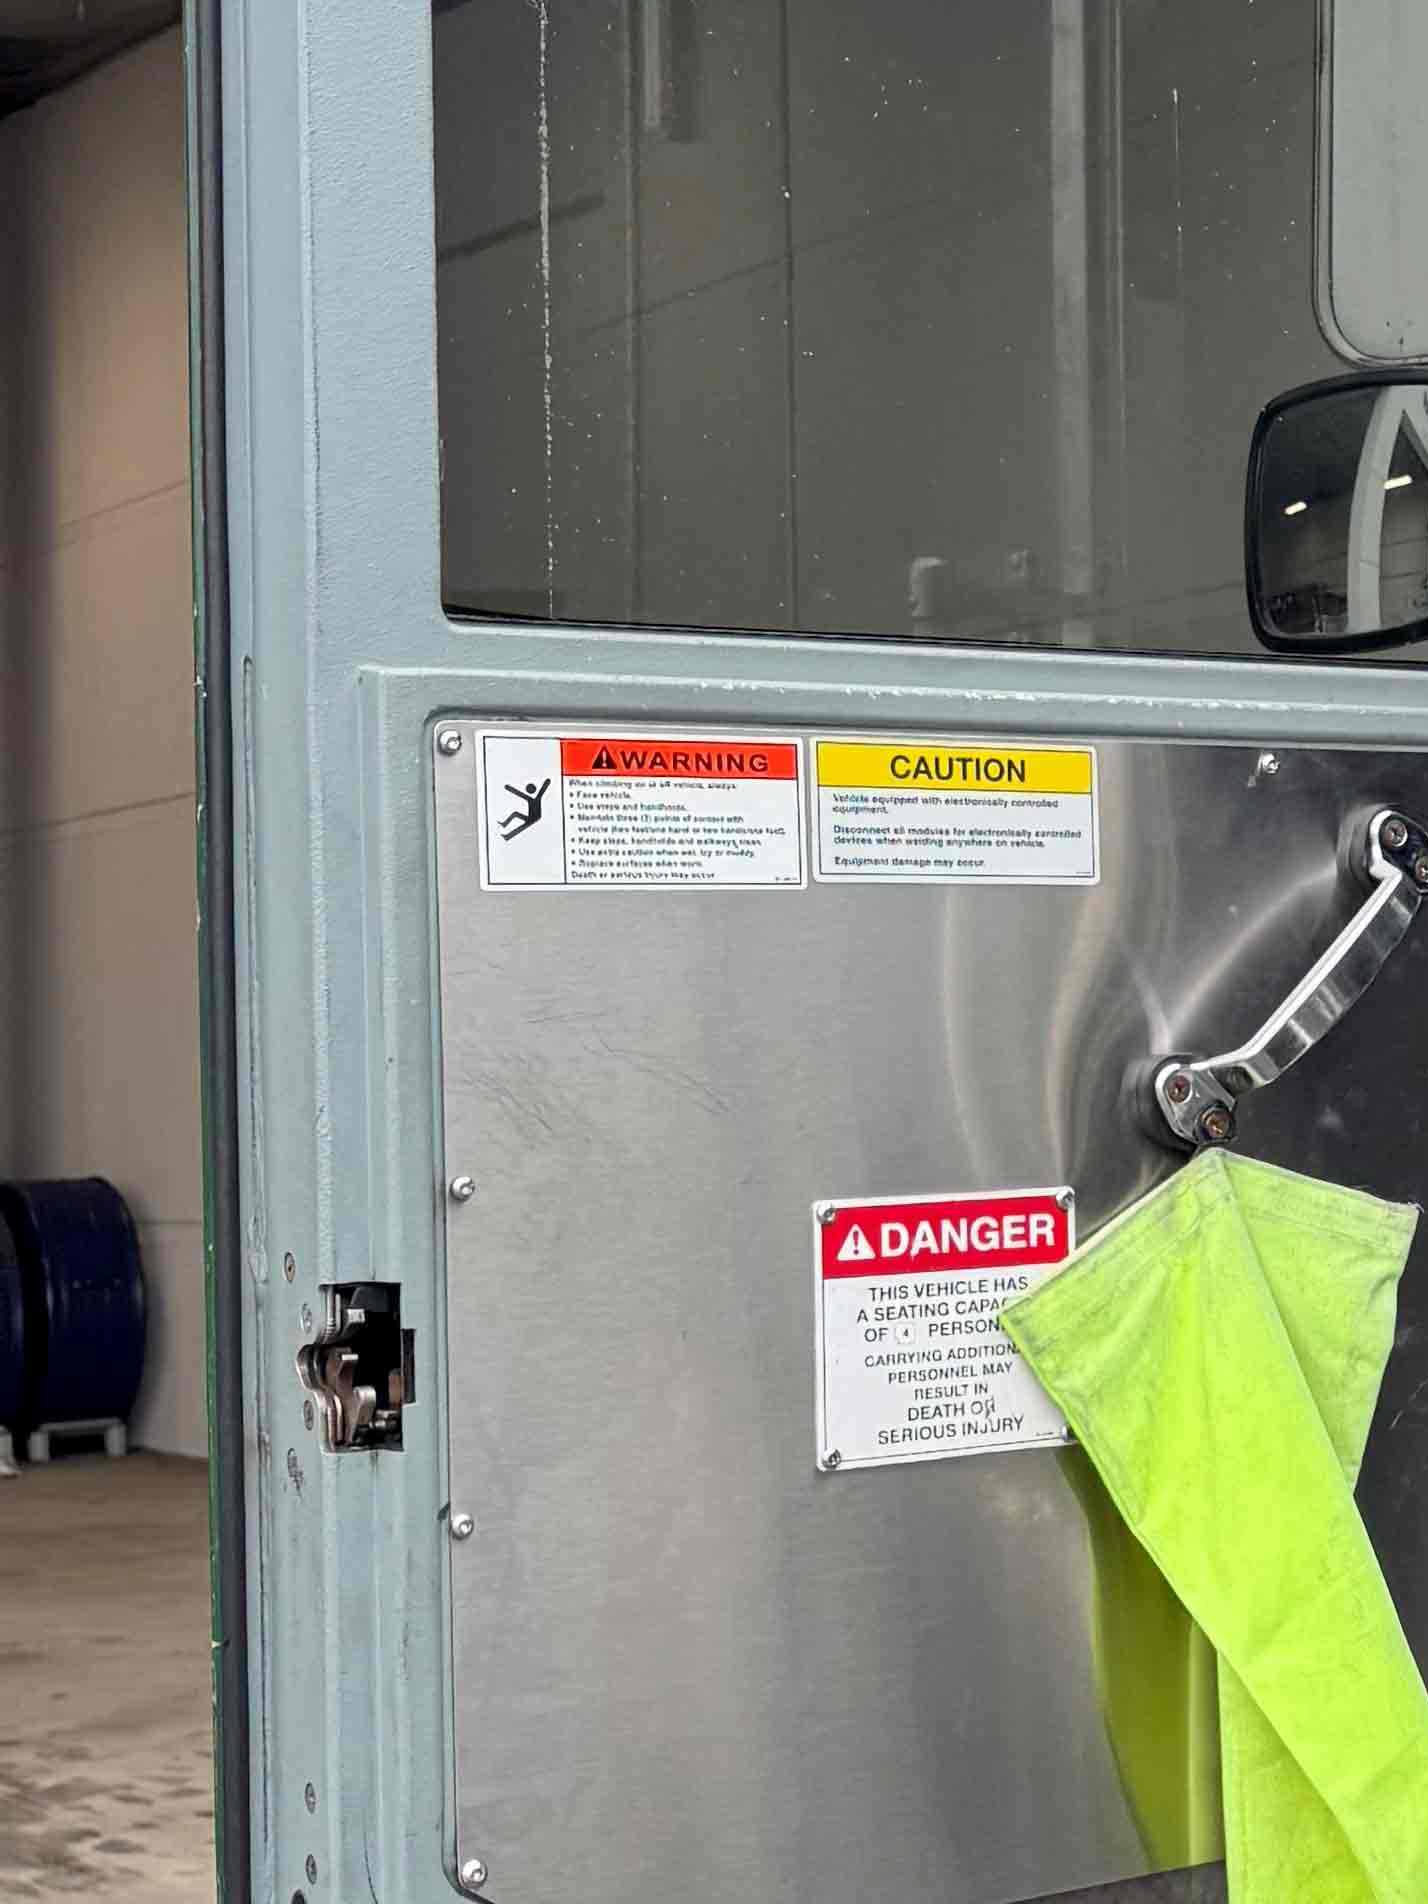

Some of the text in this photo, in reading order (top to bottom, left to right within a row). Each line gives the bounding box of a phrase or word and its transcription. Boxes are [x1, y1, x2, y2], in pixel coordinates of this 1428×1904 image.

[620, 751, 769, 772] WARNING
[890, 755, 1026, 783] CAUTION
[872, 796, 918, 805] equipped
[921, 796, 942, 804] with
[944, 797, 1008, 808] electronically
[1011, 799, 1058, 808] controlled
[833, 825, 1081, 839] Disconnect all modules for electronically controlled
[834, 836, 872, 844] devices
[946, 839, 992, 848] anywhere
[834, 857, 888, 866] Equipment
[892, 858, 930, 867] damage
[934, 860, 953, 868] may
[880, 1213, 1055, 1258] DANGER
[869, 1276, 1029, 1303] THIS VEHICLE HAS
[856, 1309, 868, 1324] A
[874, 1302, 950, 1322] SEATING
[864, 1318, 1006, 1343] OF 4 PERSON
[864, 1348, 942, 1368] CARRYING
[888, 1361, 1013, 1384] PERSONNEL MAY
[914, 1383, 989, 1401] RESULT IN
[908, 1398, 995, 1421] DEATH OR
[878, 1415, 1024, 1445] SERIOUS INJURY
